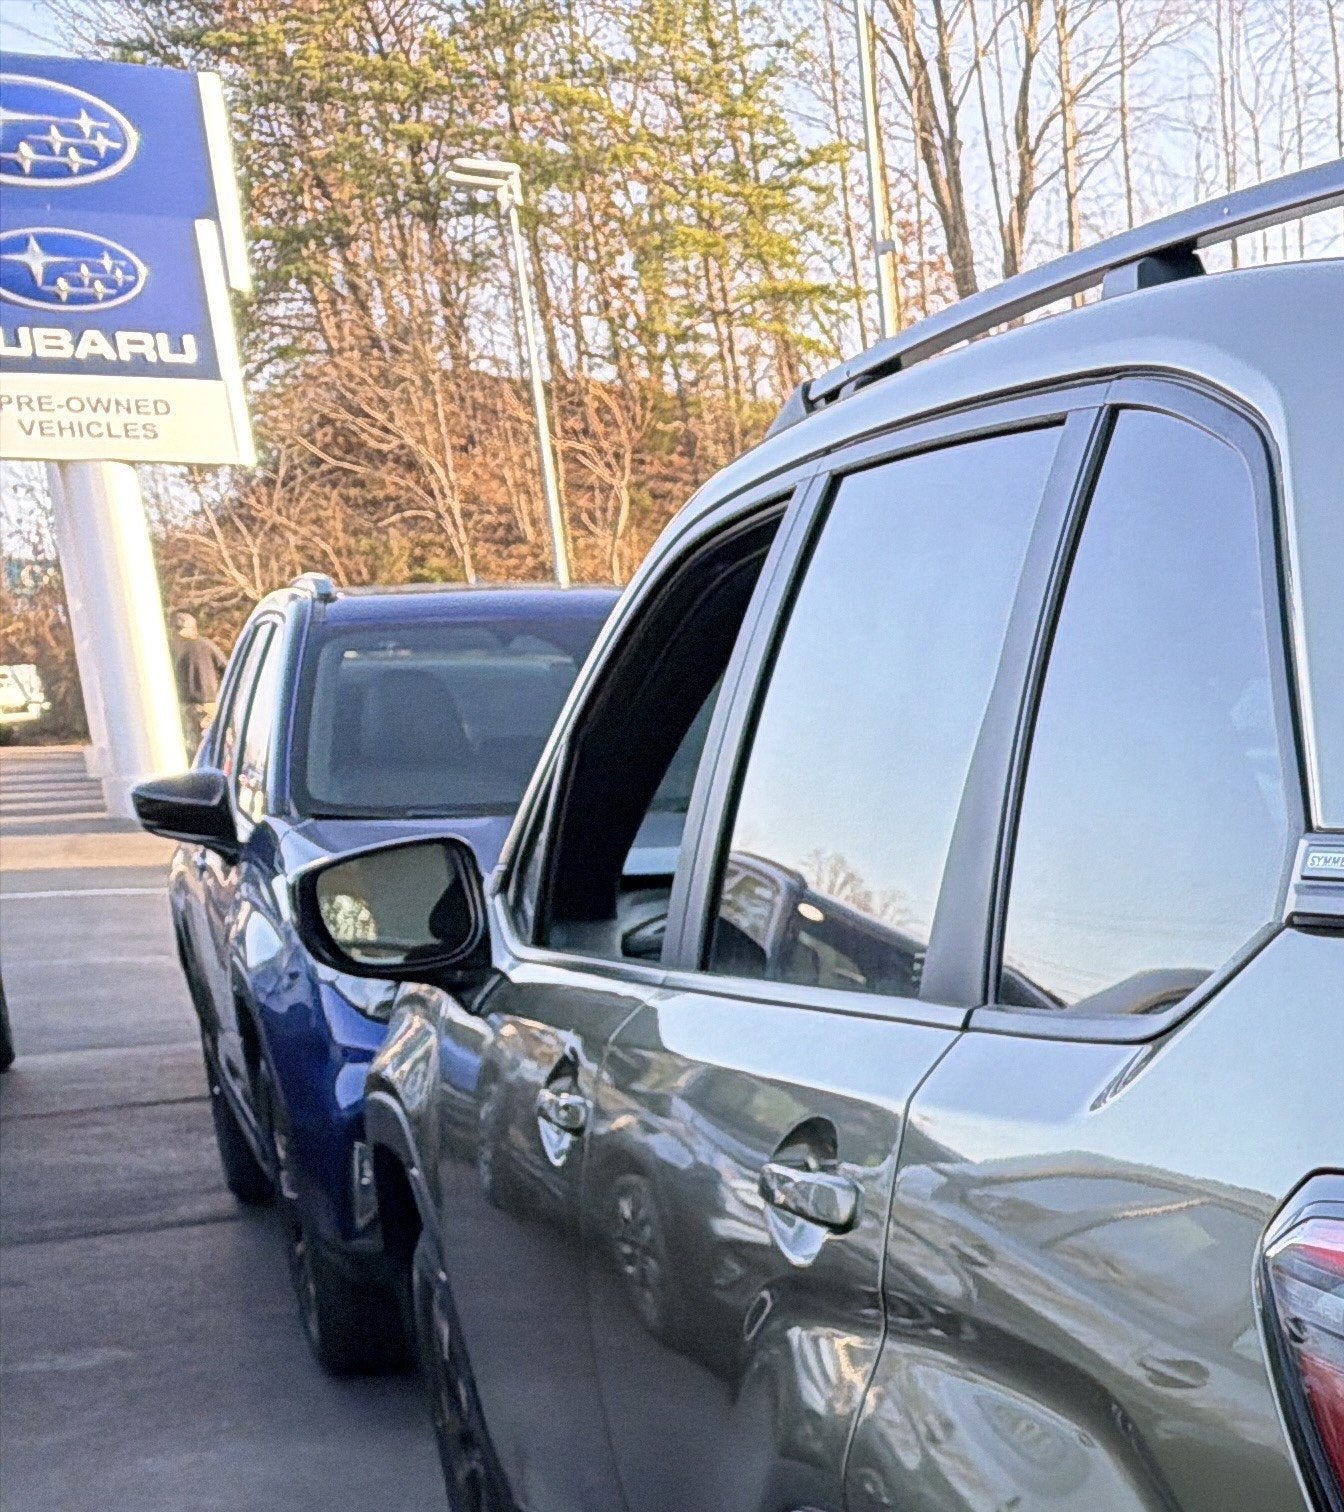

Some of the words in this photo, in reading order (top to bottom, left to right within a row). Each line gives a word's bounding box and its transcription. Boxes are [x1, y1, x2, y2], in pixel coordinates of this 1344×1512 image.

[0, 326, 198, 365] UBARU
[0, 394, 172, 416] PRE-OWNED
[17, 419, 160, 441] VEHICLES
